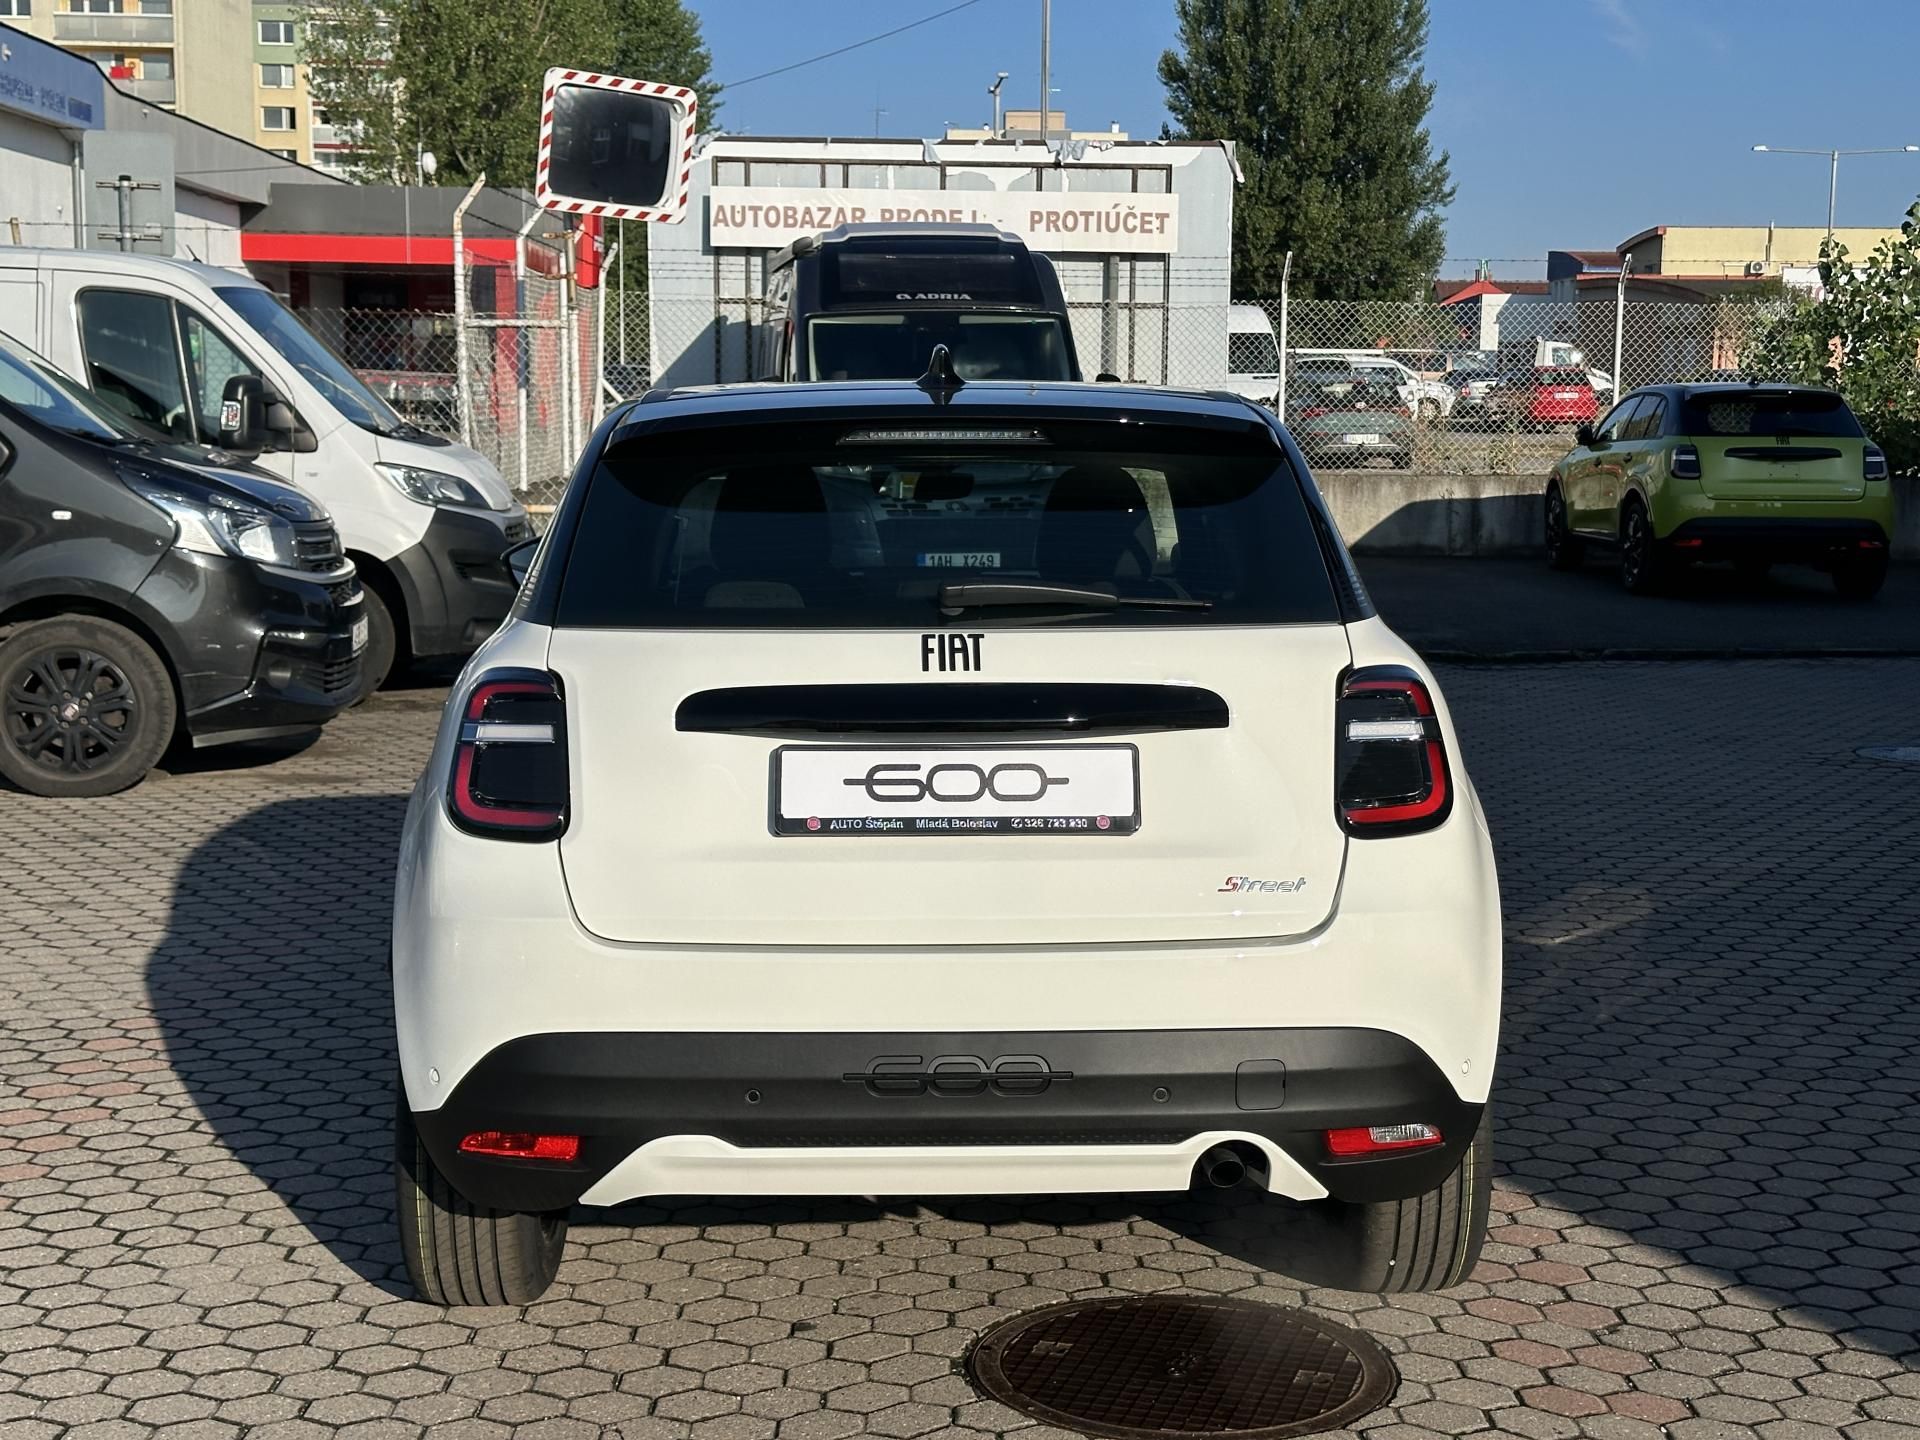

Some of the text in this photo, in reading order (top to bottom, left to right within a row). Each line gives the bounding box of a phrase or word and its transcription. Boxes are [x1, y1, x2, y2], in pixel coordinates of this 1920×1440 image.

[713, 205, 866, 229] AUTOBAZAR
[1029, 203, 1170, 234] PROTIÚČET
[928, 554, 995, 568] 1AH X249
[921, 633, 985, 672] FIAT
[864, 763, 1049, 802] 600
[830, 819, 862, 830] AUTO
[916, 819, 949, 829] Mladá
[1024, 818, 1044, 828] 326
[1217, 876, 1307, 893] Street
